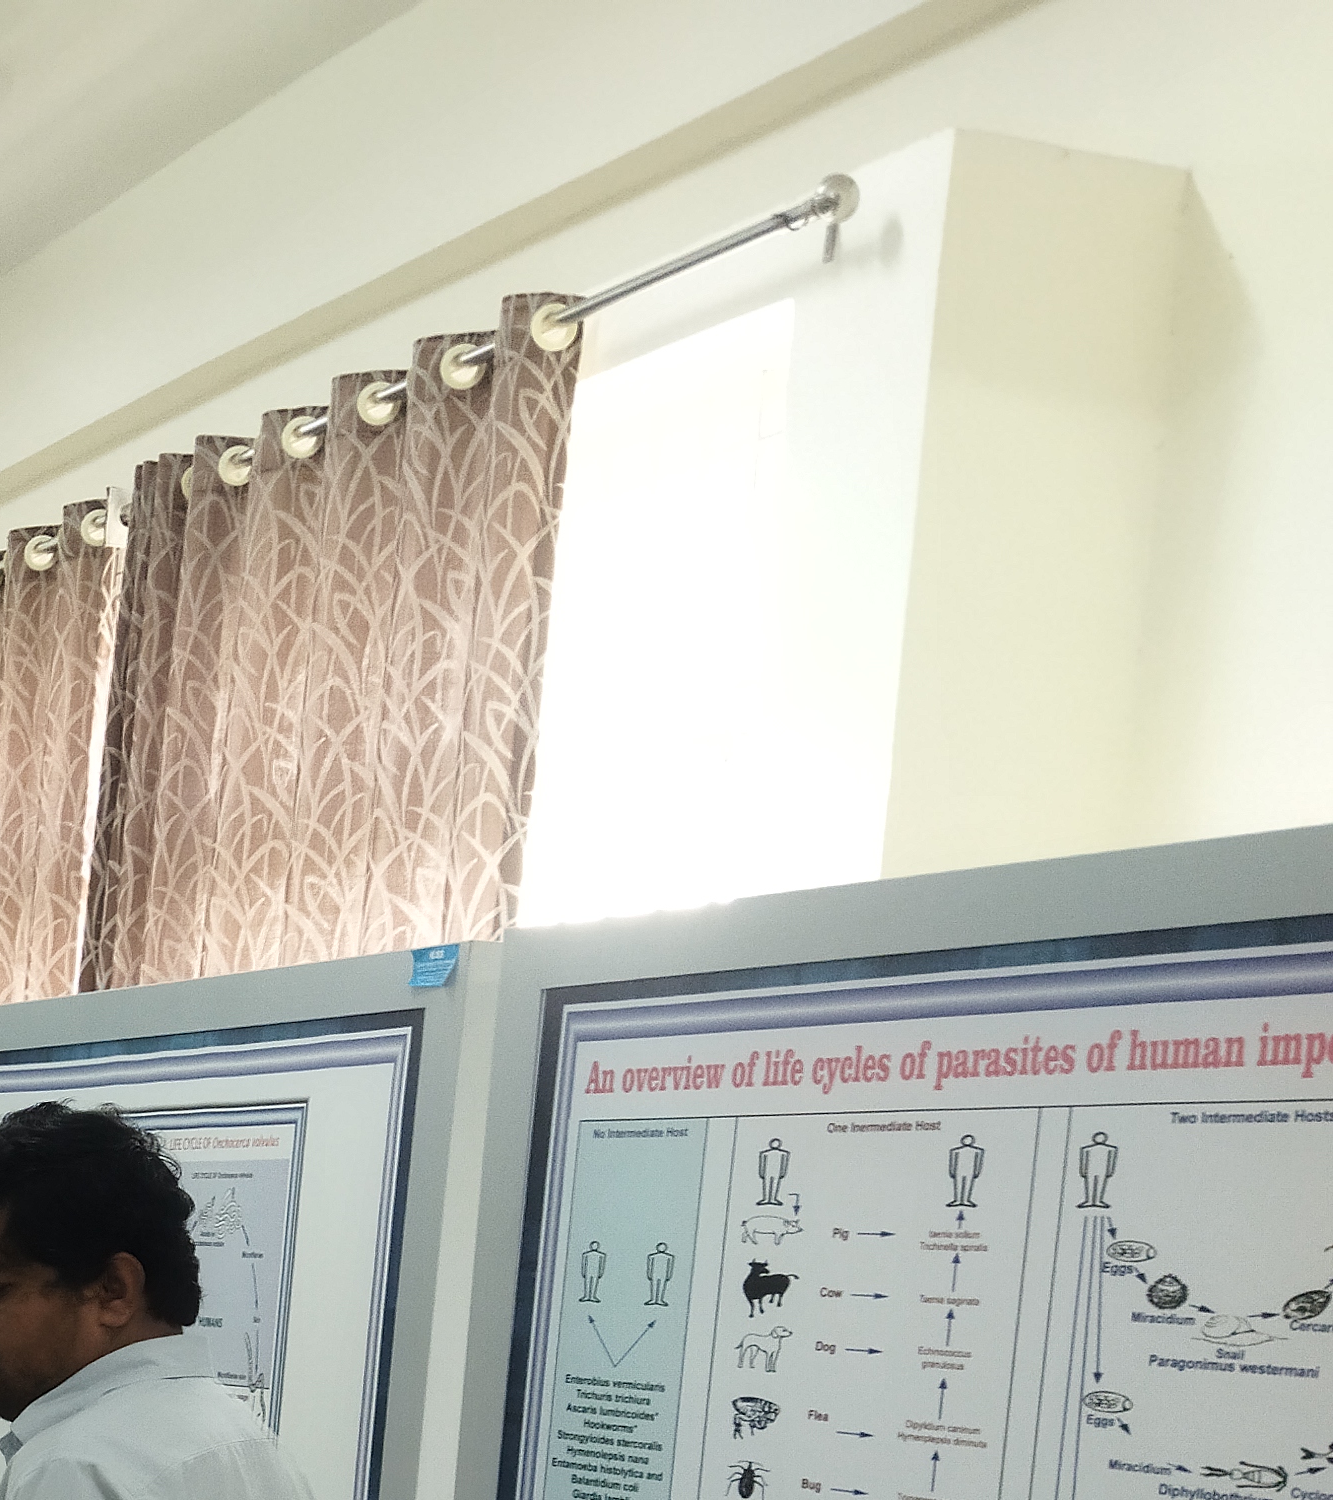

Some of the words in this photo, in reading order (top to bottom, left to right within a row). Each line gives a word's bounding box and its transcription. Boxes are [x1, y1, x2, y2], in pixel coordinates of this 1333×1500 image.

[585, 1061, 614, 1094] An
[622, 1055, 725, 1093] overview
[732, 1051, 759, 1088] of
[762, 1049, 803, 1087] life
[812, 1045, 891, 1095] cycles
[900, 1040, 932, 1080] of
[934, 1035, 1076, 1090] parasites
[1086, 1030, 1122, 1073] of
[1127, 1029, 1244, 1071] human
[1257, 1022, 1333, 1078] imp
[1171, 1111, 1197, 1124] Two
[1201, 1110, 1289, 1124] Intermediate
[594, 1129, 605, 1138] No
[666, 1128, 688, 1137] Host
[827, 1123, 847, 1133] One
[915, 1121, 941, 1131] Host
[832, 1227, 850, 1241] Pig
[1101, 1262, 1134, 1276] Eggs
[820, 1287, 843, 1298] Cow
[1131, 1312, 1196, 1325] Miracidium
[815, 1341, 836, 1354] Dog
[1216, 1349, 1245, 1360] Snail
[1148, 1354, 1235, 1372] Paragonimus
[1240, 1362, 1320, 1378] westermani
[577, 1389, 612, 1401] Trichuris
[566, 1403, 597, 1414] Ascaris
[808, 1409, 828, 1422] Flea
[1086, 1414, 1115, 1428] Eggs
[628, 1455, 649, 1465] nana
[552, 1458, 597, 1472] Entamoeba
[601, 1464, 644, 1478] histolytica
[646, 1472, 663, 1481] and
[1108, 1459, 1172, 1476] Miracidium
[571, 1474, 621, 1490] Balantidium
[802, 1478, 821, 1493] Bug
